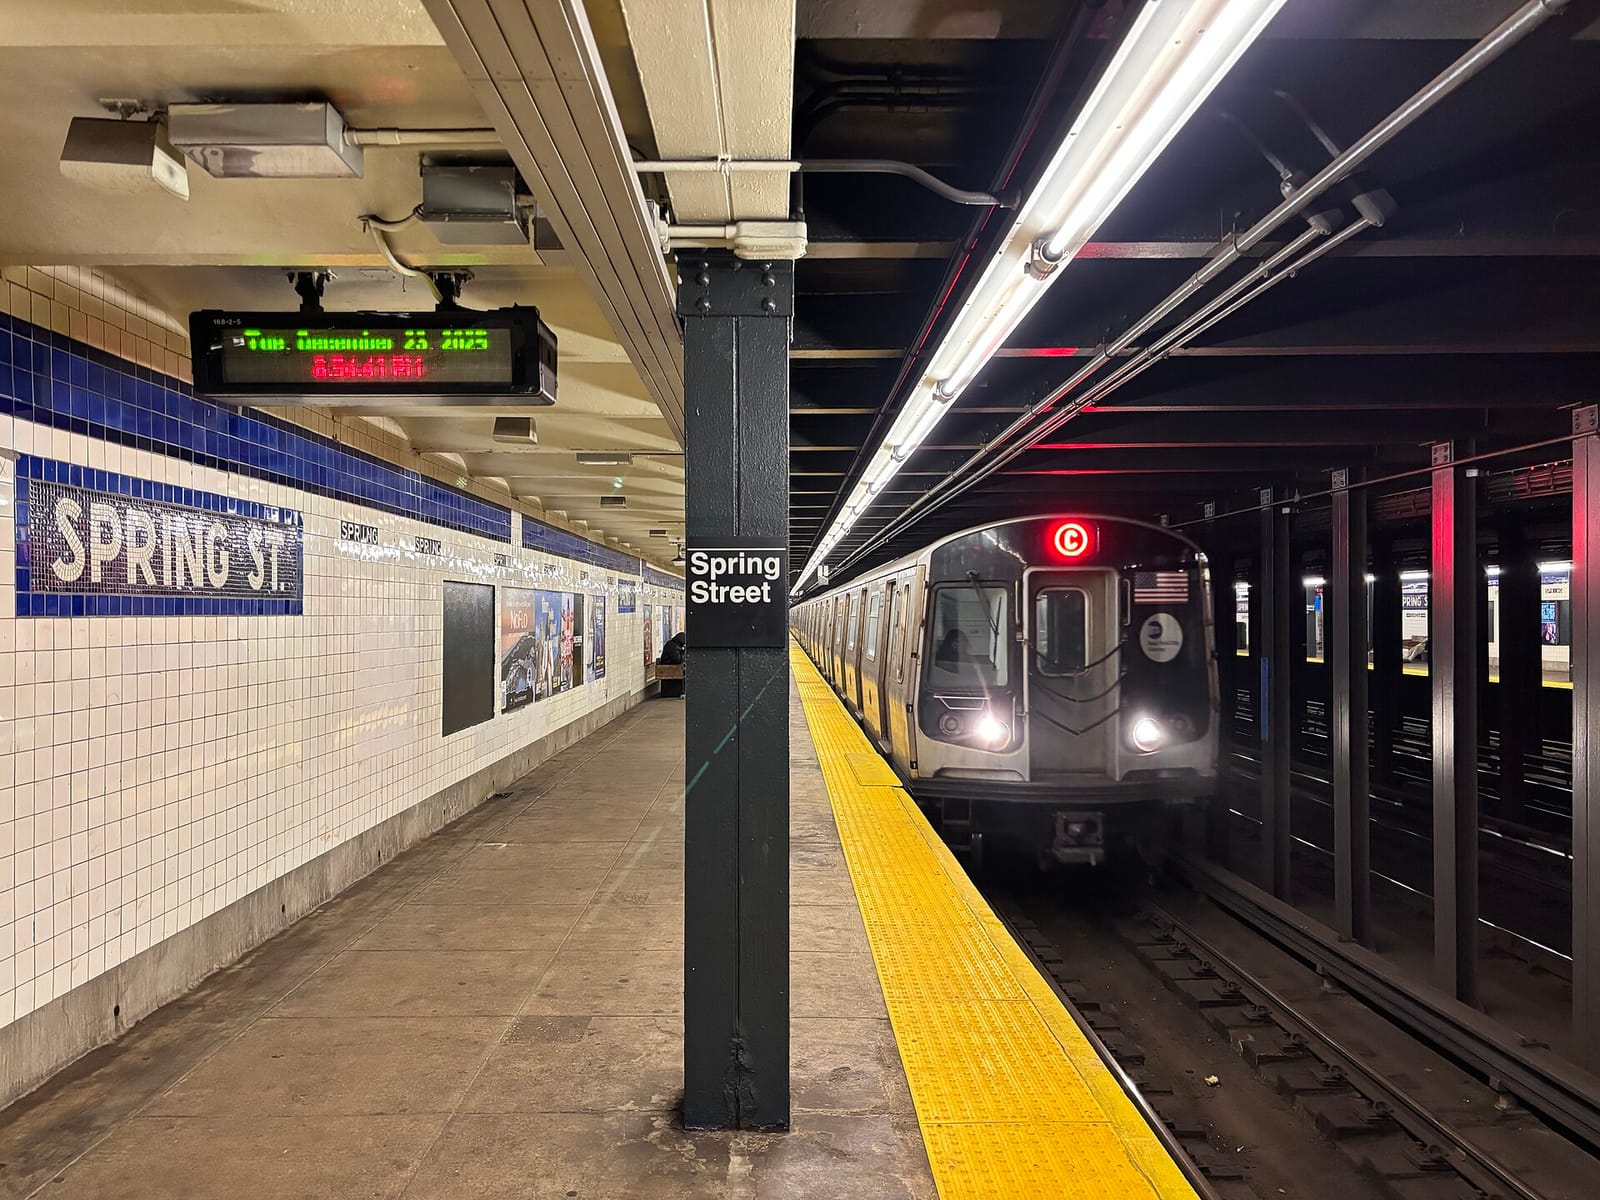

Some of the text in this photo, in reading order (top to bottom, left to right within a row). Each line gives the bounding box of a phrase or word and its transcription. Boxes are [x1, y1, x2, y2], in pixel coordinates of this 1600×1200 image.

[51, 497, 230, 589] SPRING
[341, 521, 378, 546] SPRING
[690, 551, 780, 580] Spring
[690, 580, 771, 603] Street
[1402, 596, 1421, 607] PRING
